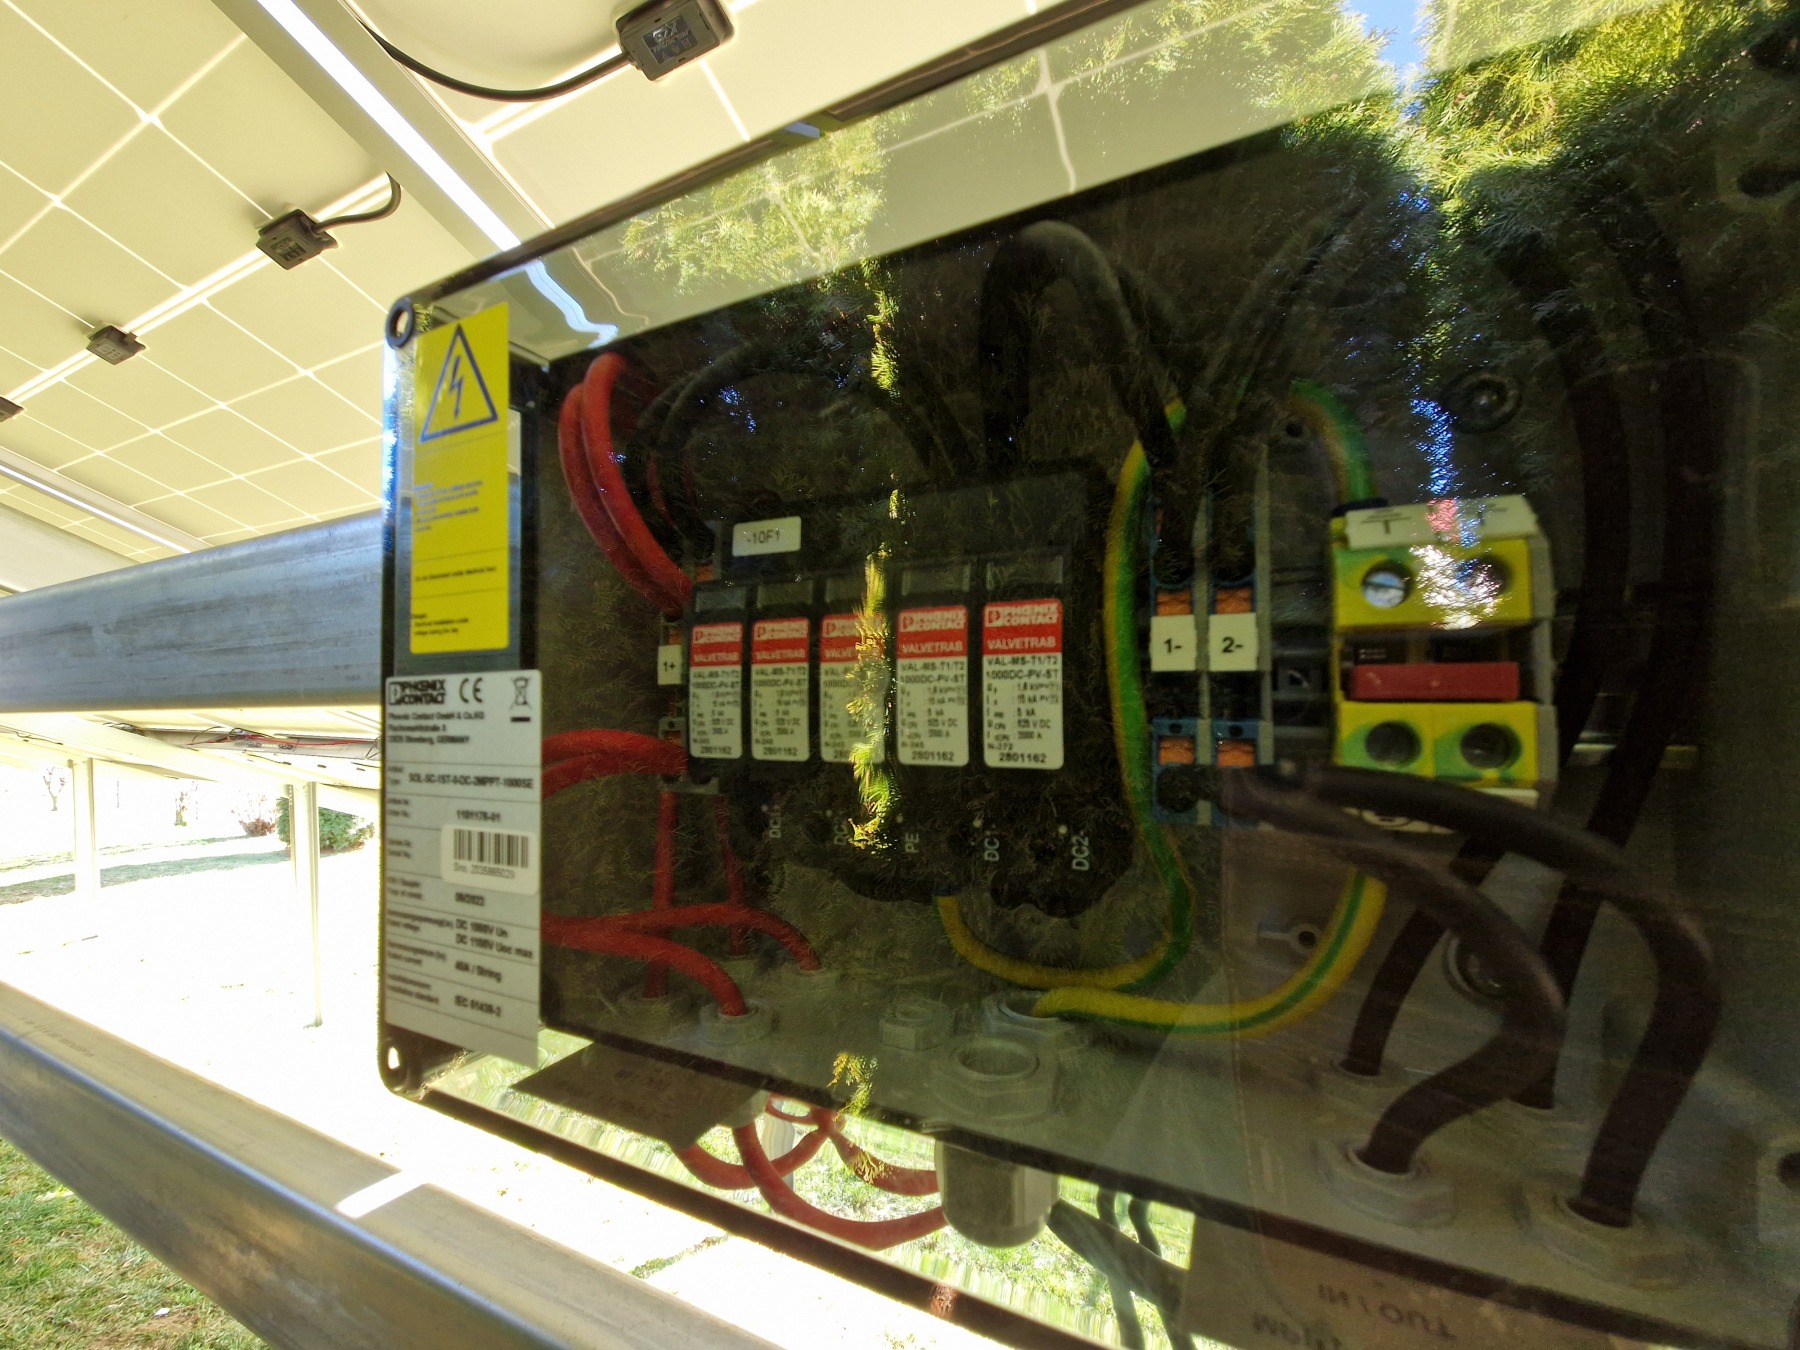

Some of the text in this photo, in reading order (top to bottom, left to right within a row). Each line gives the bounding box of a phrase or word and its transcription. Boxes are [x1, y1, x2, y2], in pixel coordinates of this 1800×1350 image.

[902, 641, 963, 653] VALVETRAB
[987, 637, 1056, 649] VALVETRAB
[1164, 638, 1182, 653] 1-
[1222, 636, 1244, 653] 2-
[663, 661, 676, 672] 1+
[401, 692, 446, 705] CONTACT
[1000, 753, 1047, 763] 2801162
[904, 832, 920, 853] PE
